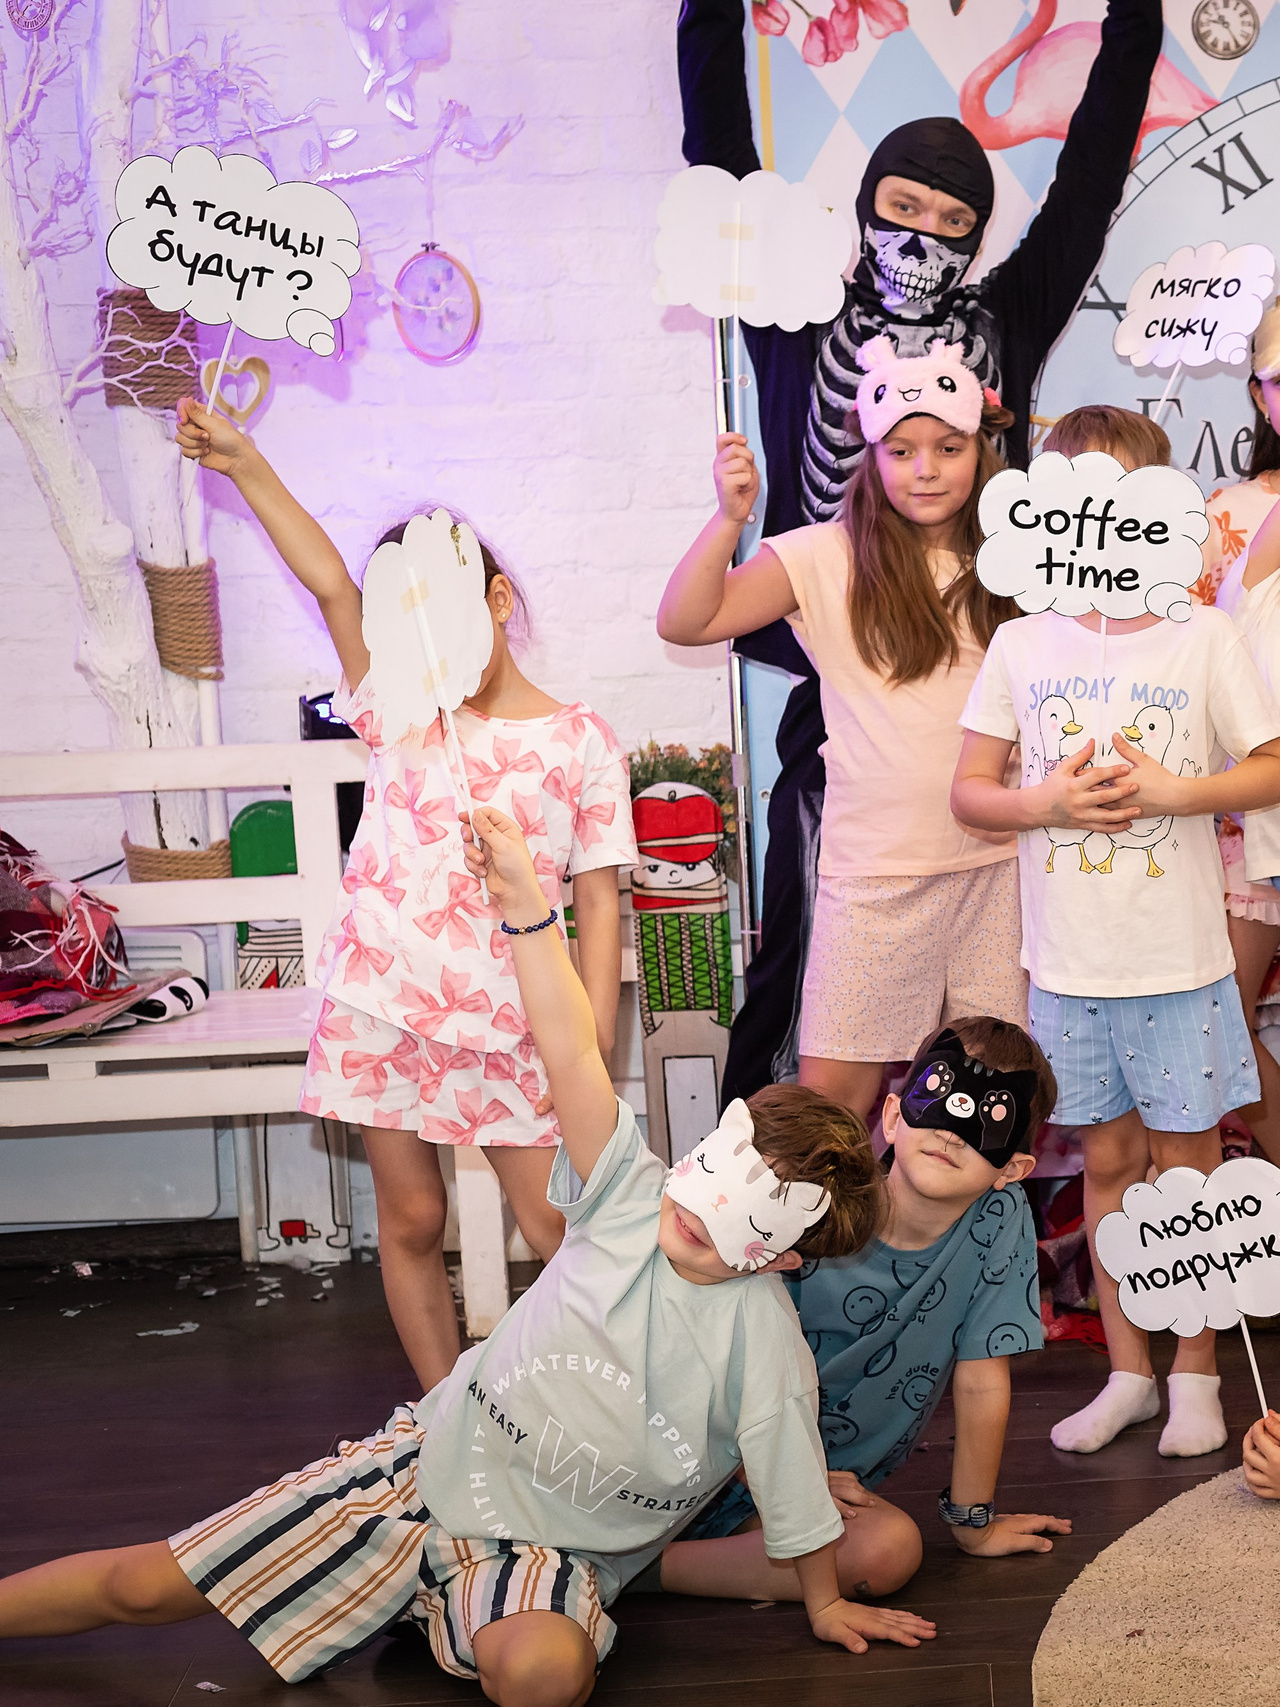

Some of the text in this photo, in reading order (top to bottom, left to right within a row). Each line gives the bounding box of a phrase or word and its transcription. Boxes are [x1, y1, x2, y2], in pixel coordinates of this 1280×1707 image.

[1192, 132, 1274, 214] XI
[145, 185, 324, 258] А танцы
[148, 229, 274, 301] будут
[1151, 277, 1241, 300] мягко
[1144, 318, 1218, 351] сижу
[1035, 547, 1140, 592] time
[1029, 676, 1189, 711] SUNDAY MOOD
[1139, 1194, 1262, 1248] люблю
[905, 1362, 940, 1378] dude
[468, 1380, 528, 1446] AN EASY
[492, 1354, 701, 1488] WHATEVER PPENS
